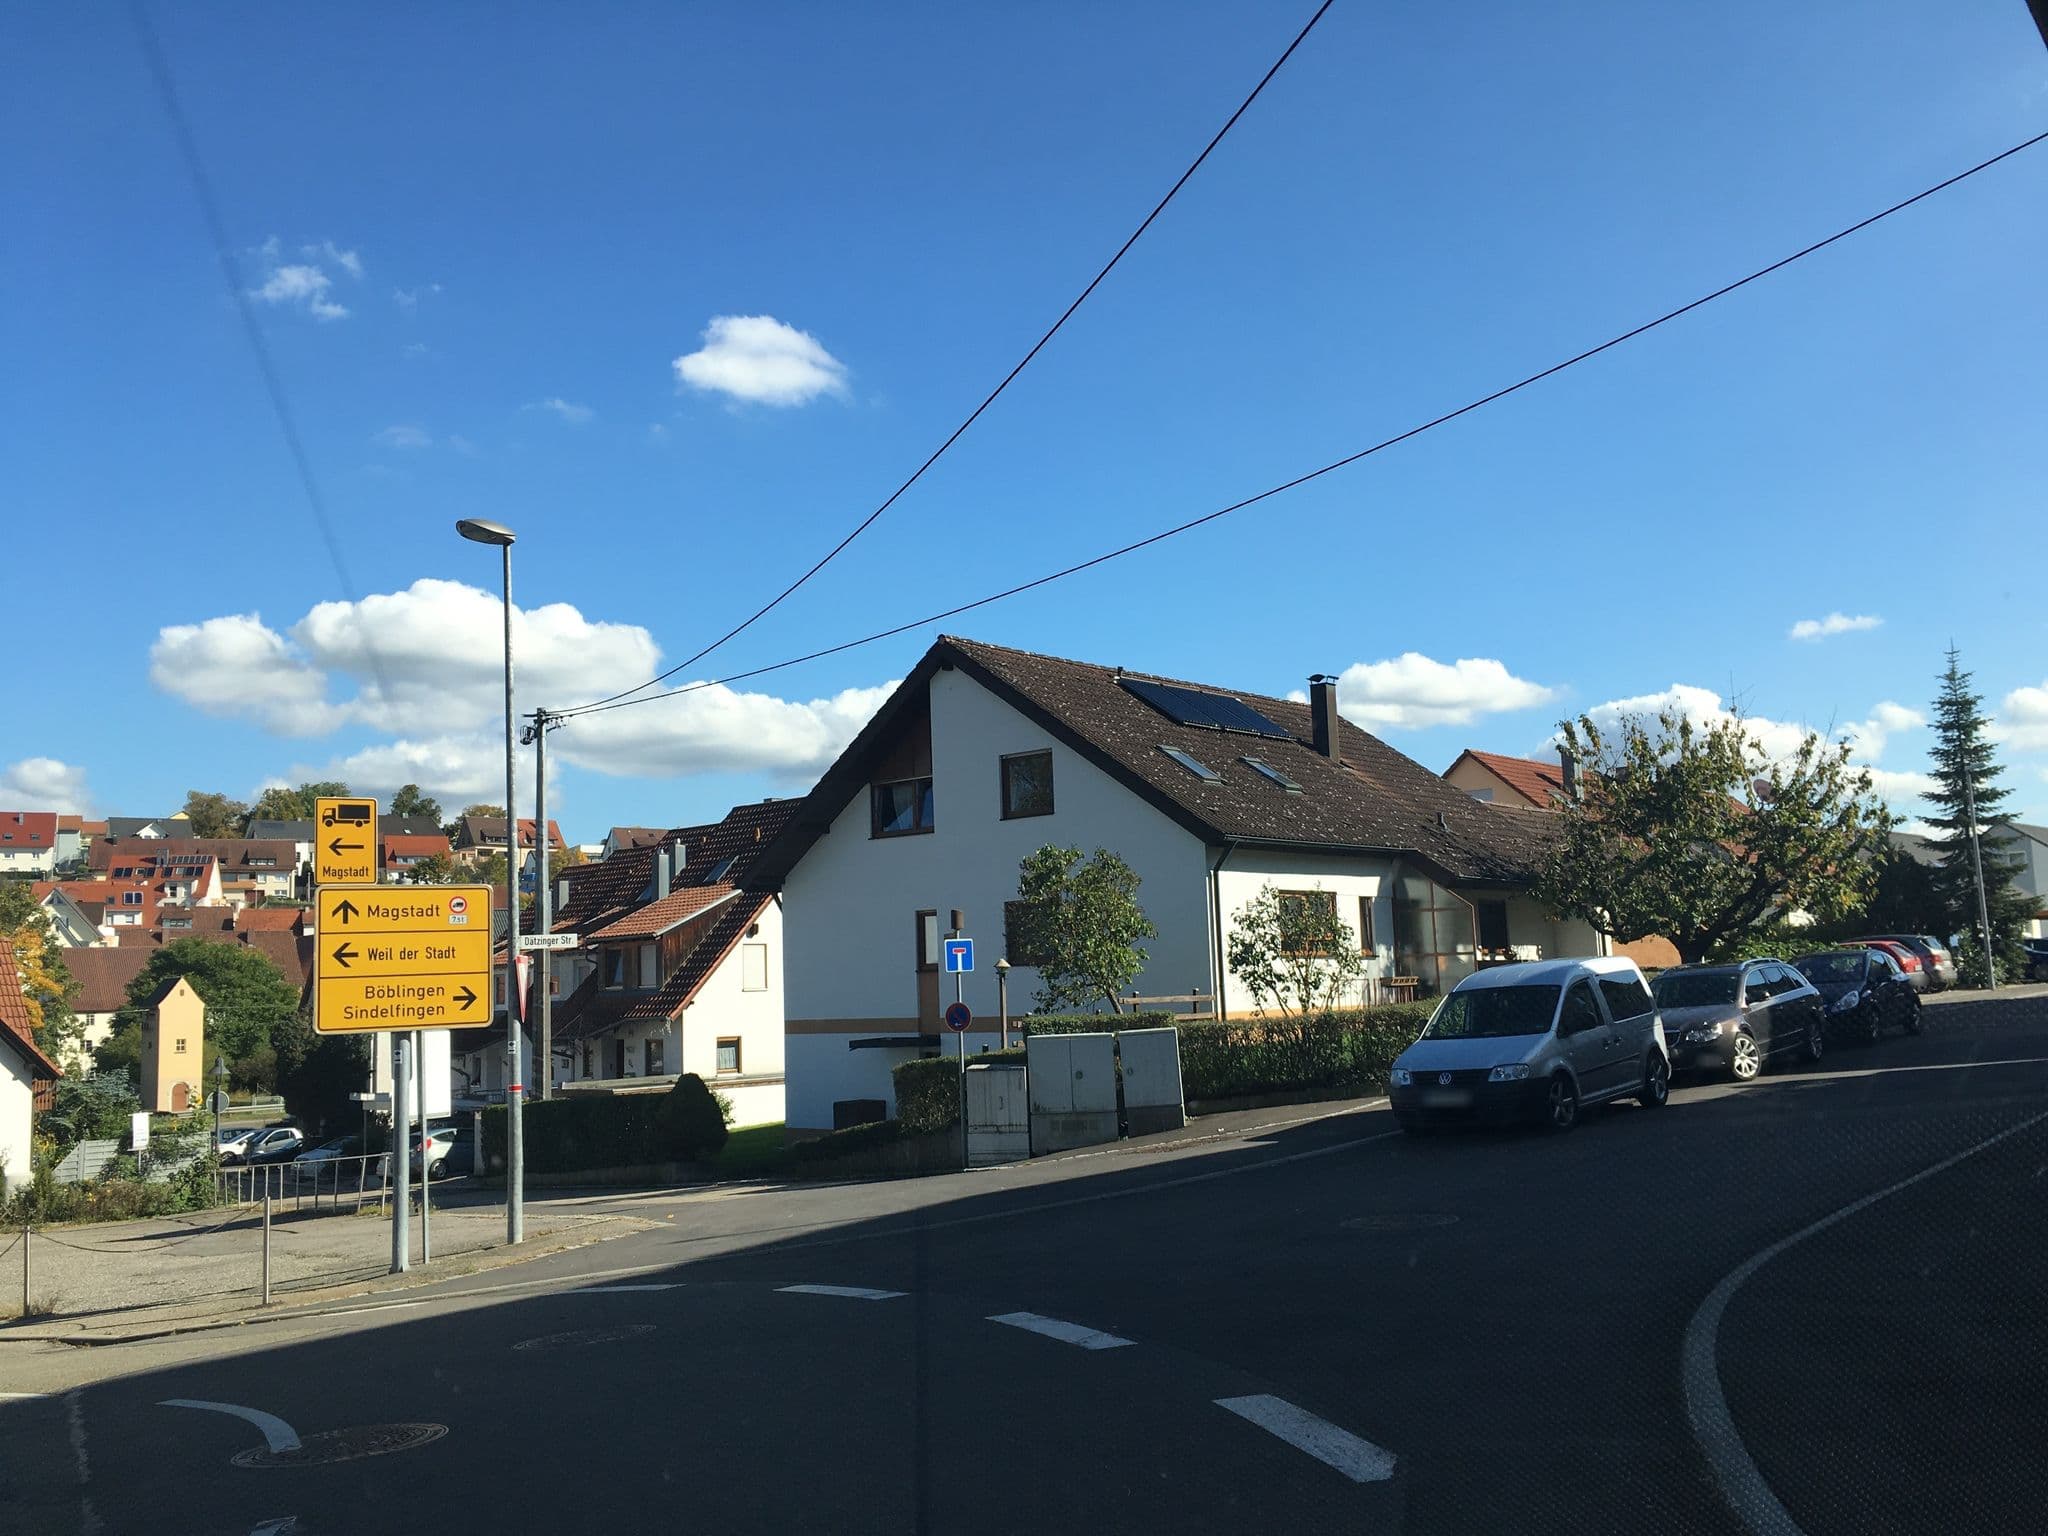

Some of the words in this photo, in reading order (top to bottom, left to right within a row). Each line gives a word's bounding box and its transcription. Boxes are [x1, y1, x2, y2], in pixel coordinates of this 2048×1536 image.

[322, 866, 369, 879] Magstadt
[367, 904, 440, 921] Magstadt
[524, 936, 559, 947] Dätzinger
[561, 936, 574, 945] Str.
[367, 948, 393, 961] Weil
[399, 946, 419, 960] der
[425, 945, 456, 959] Stadt
[365, 985, 445, 1000] Böblingen
[344, 1004, 445, 1019] Sindelfingen
